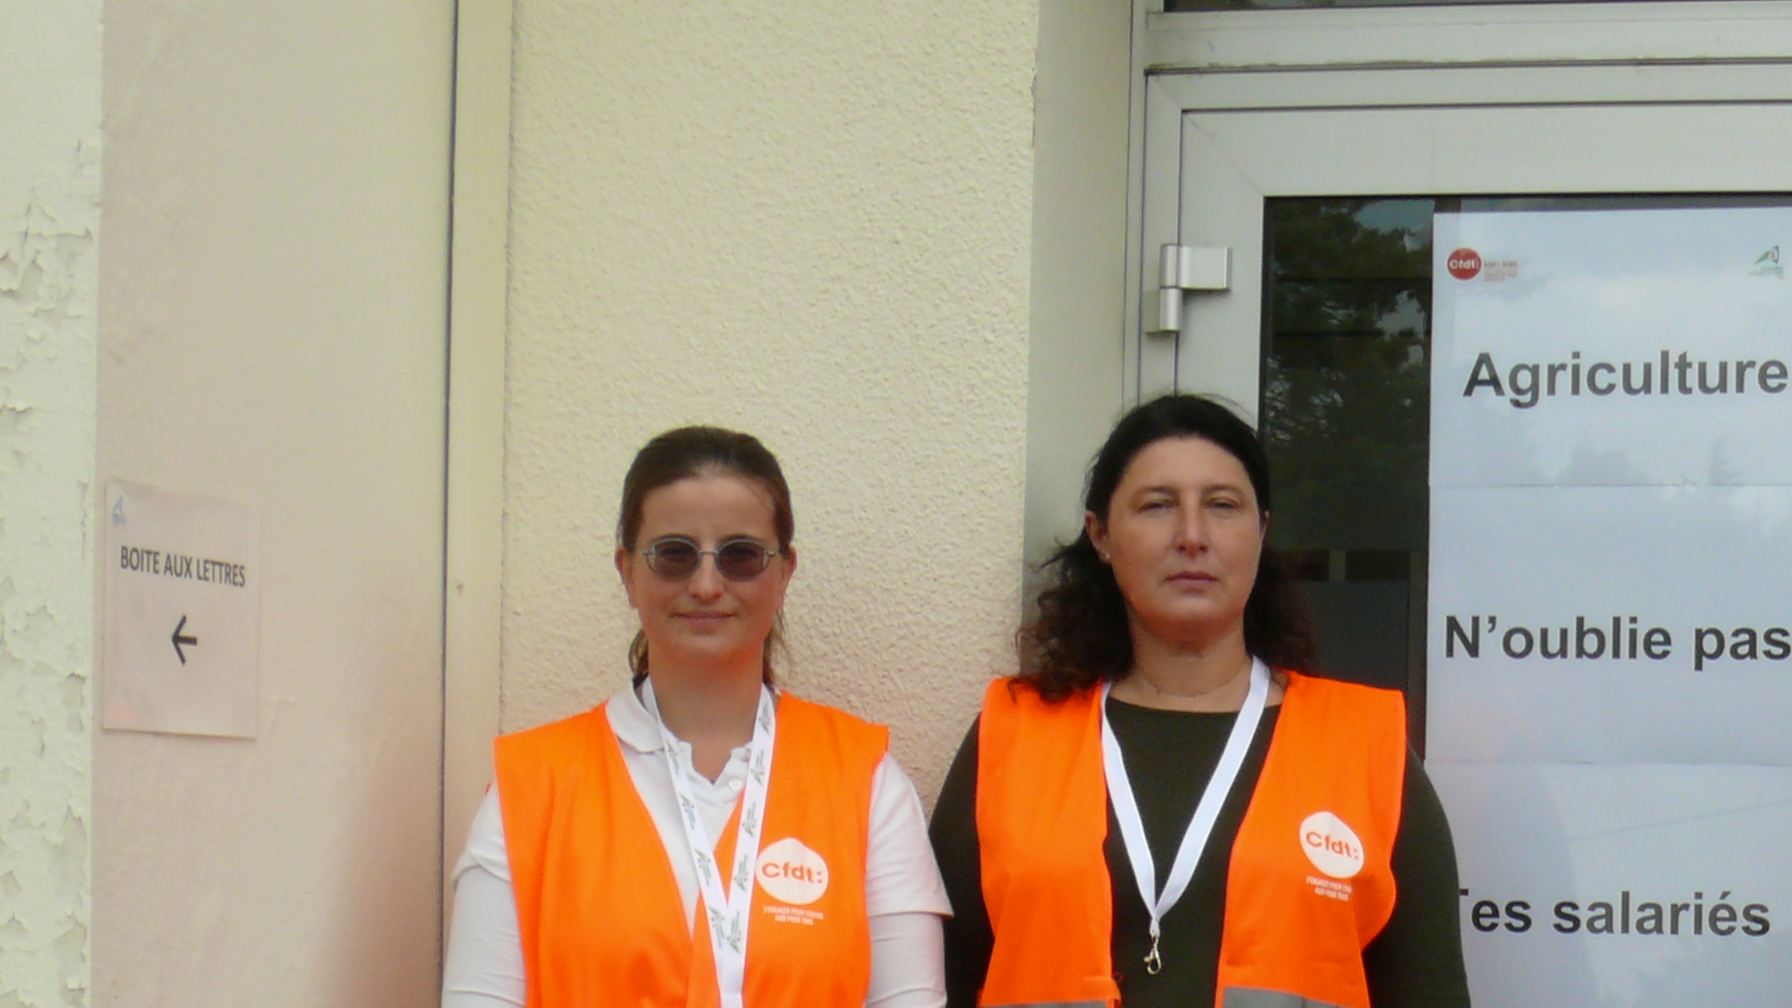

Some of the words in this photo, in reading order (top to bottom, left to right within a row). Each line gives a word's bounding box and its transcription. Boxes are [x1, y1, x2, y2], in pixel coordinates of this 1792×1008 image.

[1462, 350, 1788, 409] Agriculture
[120, 545, 160, 574] BOITE
[163, 552, 193, 579] AUX
[196, 557, 246, 588] LETTRES
[1445, 615, 1673, 660] N’oublie
[1693, 627, 1792, 671] pas
[1306, 831, 1360, 861] Cfdt:
[761, 861, 823, 884] Cfdt:
[1459, 888, 1532, 933] es
[1552, 890, 1771, 937] salariés
